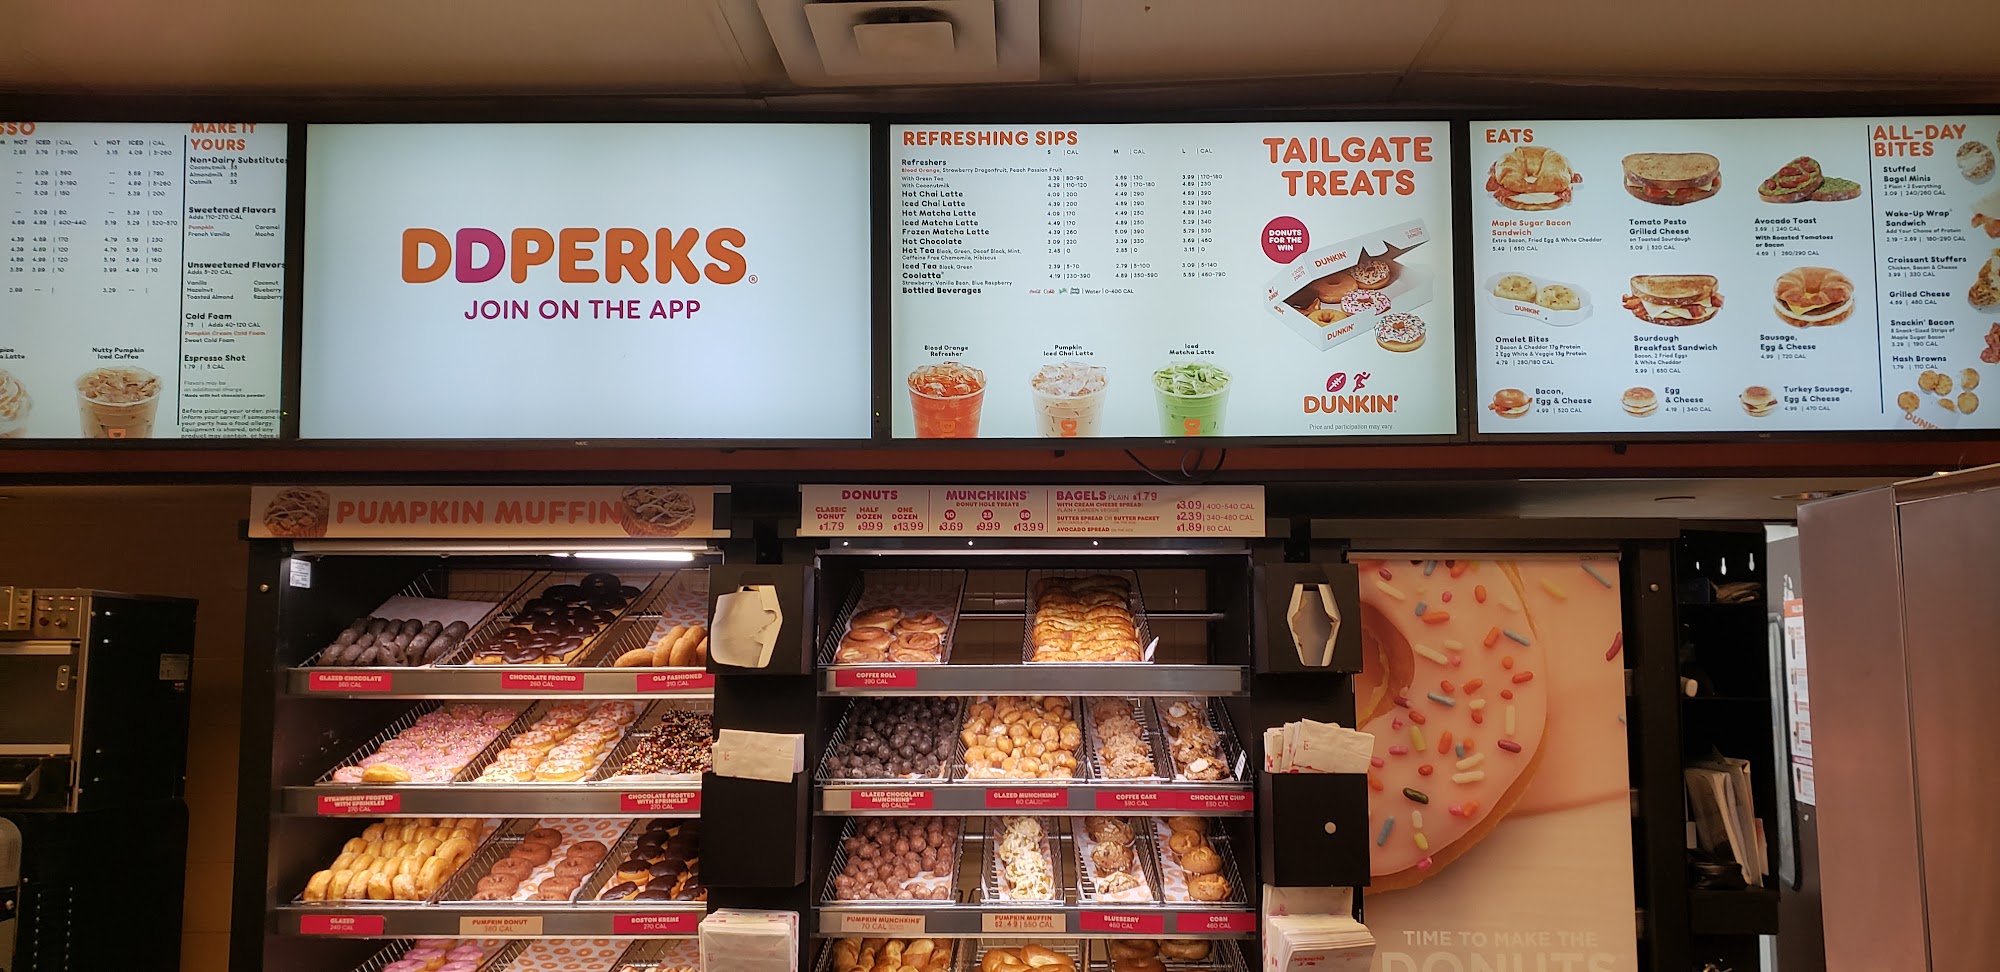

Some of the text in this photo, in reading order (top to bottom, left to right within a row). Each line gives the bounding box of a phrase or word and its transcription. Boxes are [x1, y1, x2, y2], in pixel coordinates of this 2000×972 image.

[190, 123, 257, 134] MAKE IT
[1873, 124, 1966, 140] ALL-DAY
[904, 131, 1077, 146] REFRESHING SIPS
[1486, 129, 1533, 143] EATS
[190, 138, 245, 150] YOURS
[1874, 141, 1934, 157] BITES
[1263, 136, 1433, 164] TAILGATE
[1281, 170, 1415, 196] TREATS
[1884, 175, 1906, 184] Bagel
[189, 206, 240, 214] Sweetened
[1492, 220, 1517, 228] Maple
[1519, 220, 1544, 228] Sugar
[401, 228, 747, 284] DDPERKS
[1314, 251, 1347, 268] DUNKIN'
[464, 300, 700, 320] JOIN ON THE APP
[1327, 323, 1355, 341] DUNKIN'
[1760, 334, 1797, 342] Sausage,
[1760, 344, 1776, 352] Egg
[1665, 387, 1680, 395] Egg
[1784, 386, 1852, 394] Turkey Sausage,
[1304, 395, 1398, 414] DUNKIN'
[1536, 398, 1551, 406] Egg
[1784, 396, 1799, 404] Egg
[1309, 423, 1324, 431] Price
[1335, 423, 1368, 432] participation
[842, 490, 898, 500] DONUTS
[1056, 490, 1107, 501] BAGELS
[1133, 492, 1157, 501] $1.79
[1176, 500, 1201, 510] $3.09
[336, 501, 620, 524] PUMPKIN MUFFIN
[1177, 512, 1201, 520] $2.39
[820, 522, 844, 530] $1.79
[858, 522, 883, 530] $9.99
[894, 522, 924, 531] $13.99
[939, 522, 963, 531] $3.69
[976, 522, 1000, 531] $9.99
[1013, 522, 1044, 531] $13.99
[1177, 522, 1201, 532] $1.89
[1403, 930, 1598, 947] TIME TO MAKE THE
